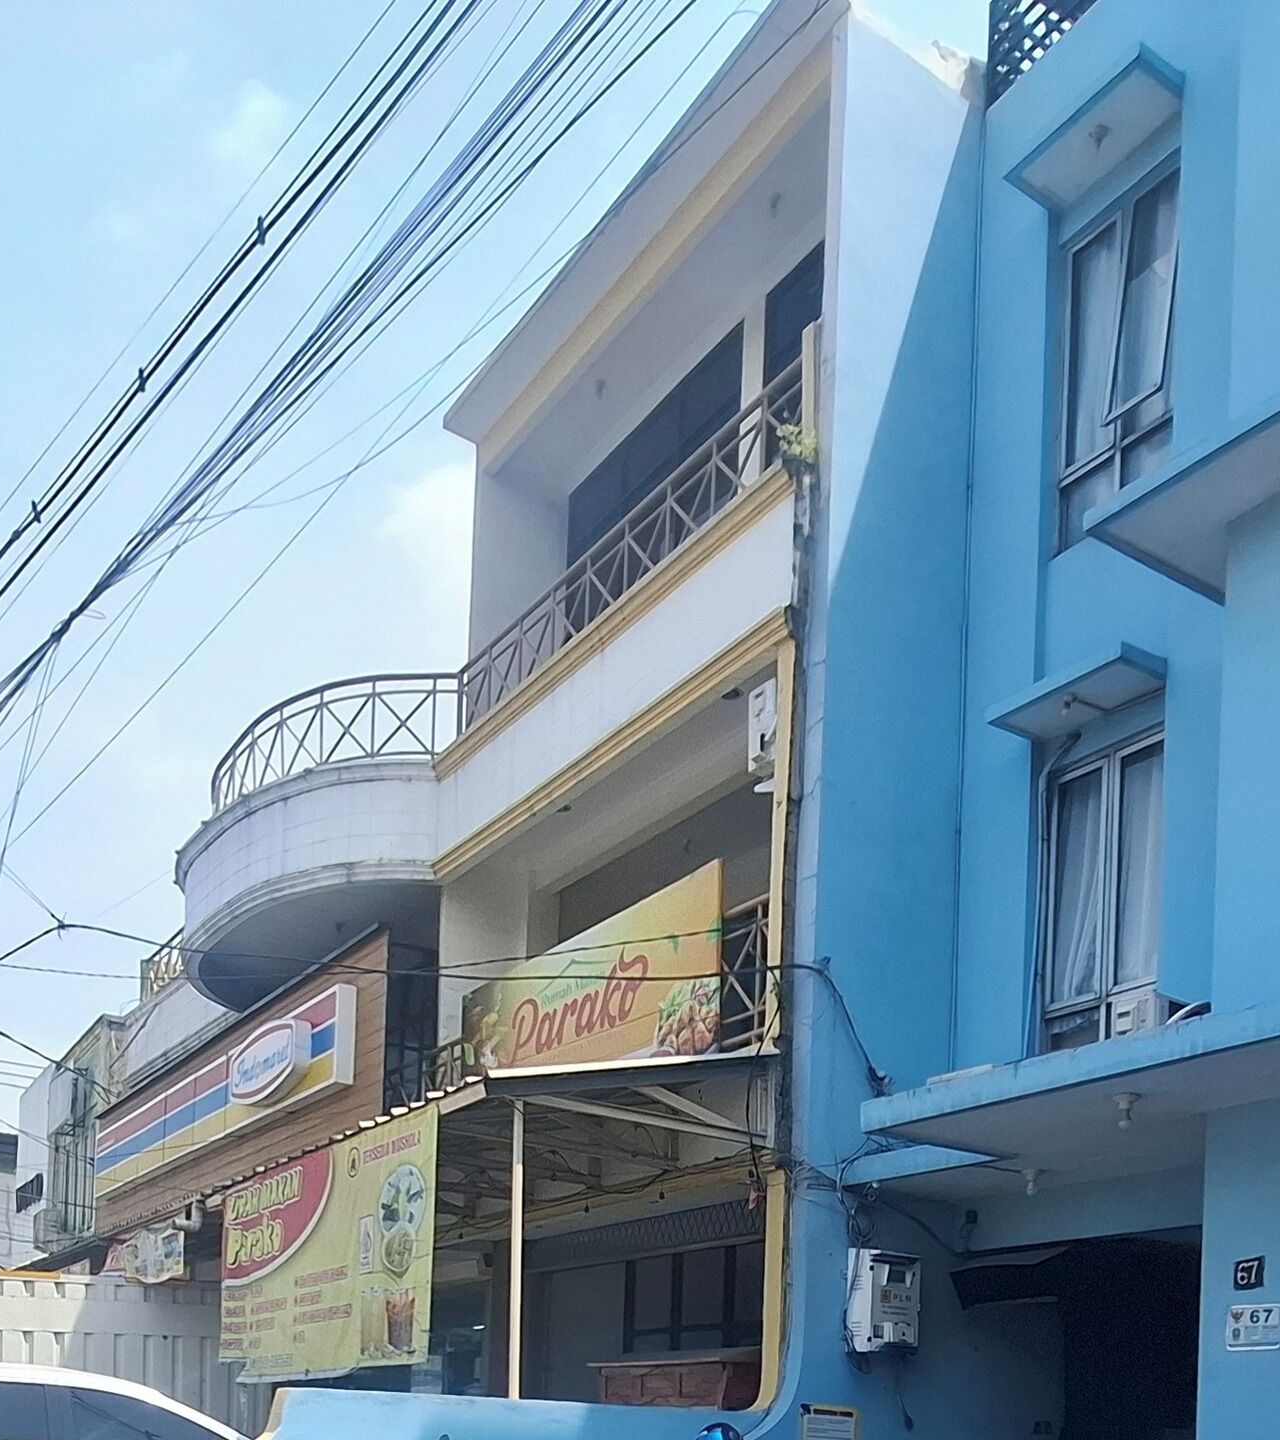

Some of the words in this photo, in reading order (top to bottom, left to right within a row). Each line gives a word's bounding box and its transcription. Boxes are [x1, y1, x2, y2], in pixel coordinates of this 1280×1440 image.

[508, 946, 649, 1067] Parako
[234, 1033, 291, 1088] Indomaret
[1237, 1260, 1259, 1285] 67
[1250, 1309, 1274, 1324] 67
